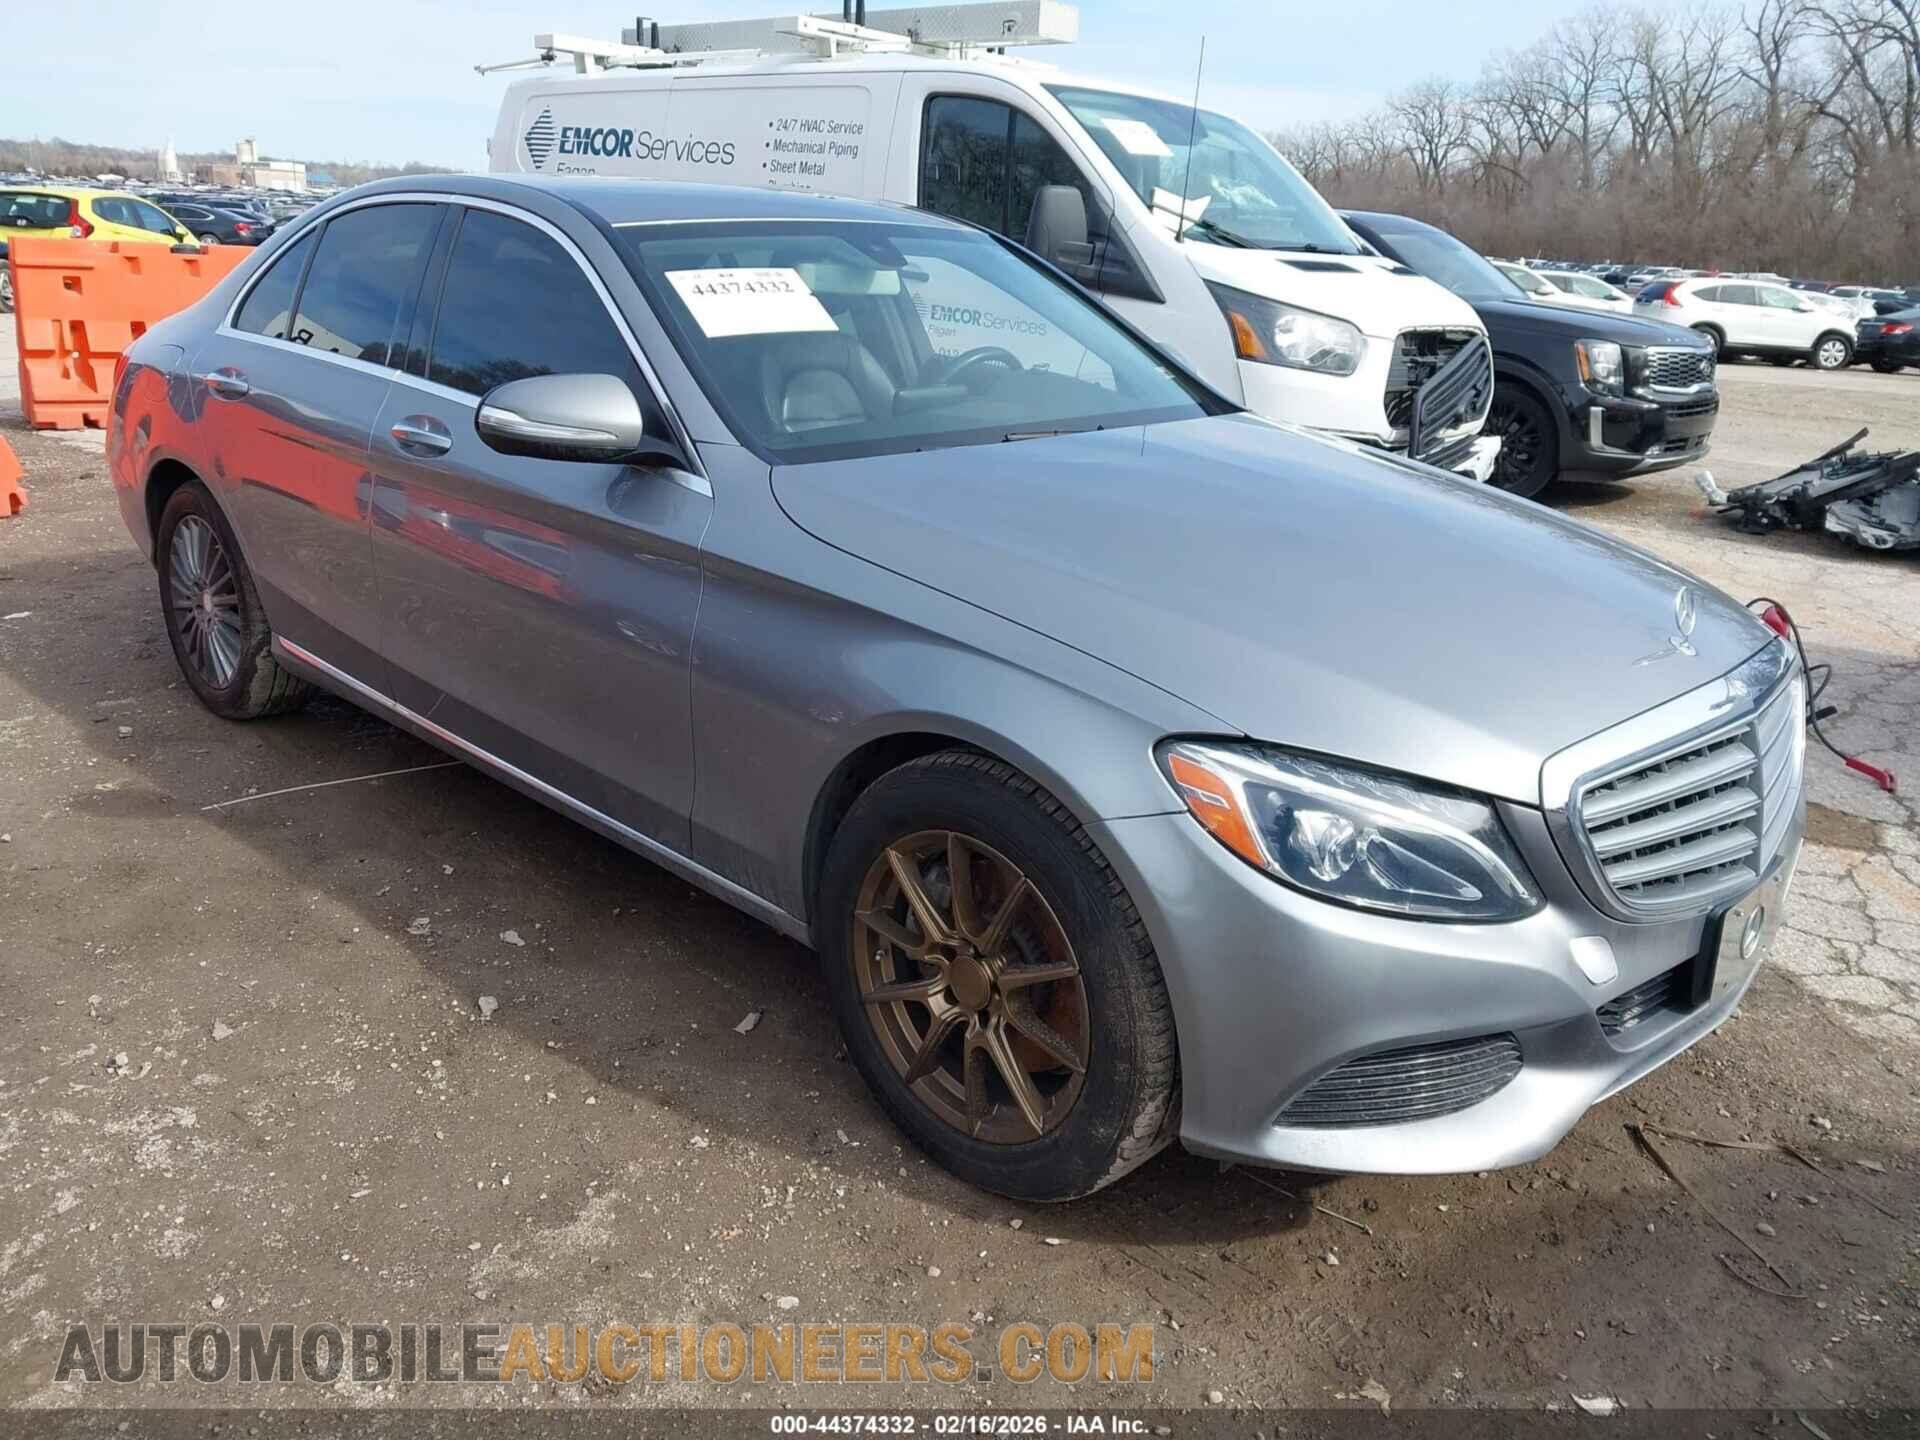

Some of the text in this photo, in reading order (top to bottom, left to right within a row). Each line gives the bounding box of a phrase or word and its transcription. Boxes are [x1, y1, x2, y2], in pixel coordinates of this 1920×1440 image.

[775, 118, 864, 135] 24/7 HVAC Service
[558, 126, 735, 165] EMCOR Services
[773, 138, 859, 159] Mechanical Piping
[770, 159, 825, 175] Sheet Metal
[692, 280, 794, 296] 44374332
[930, 304, 1048, 337] EMCOR Services
